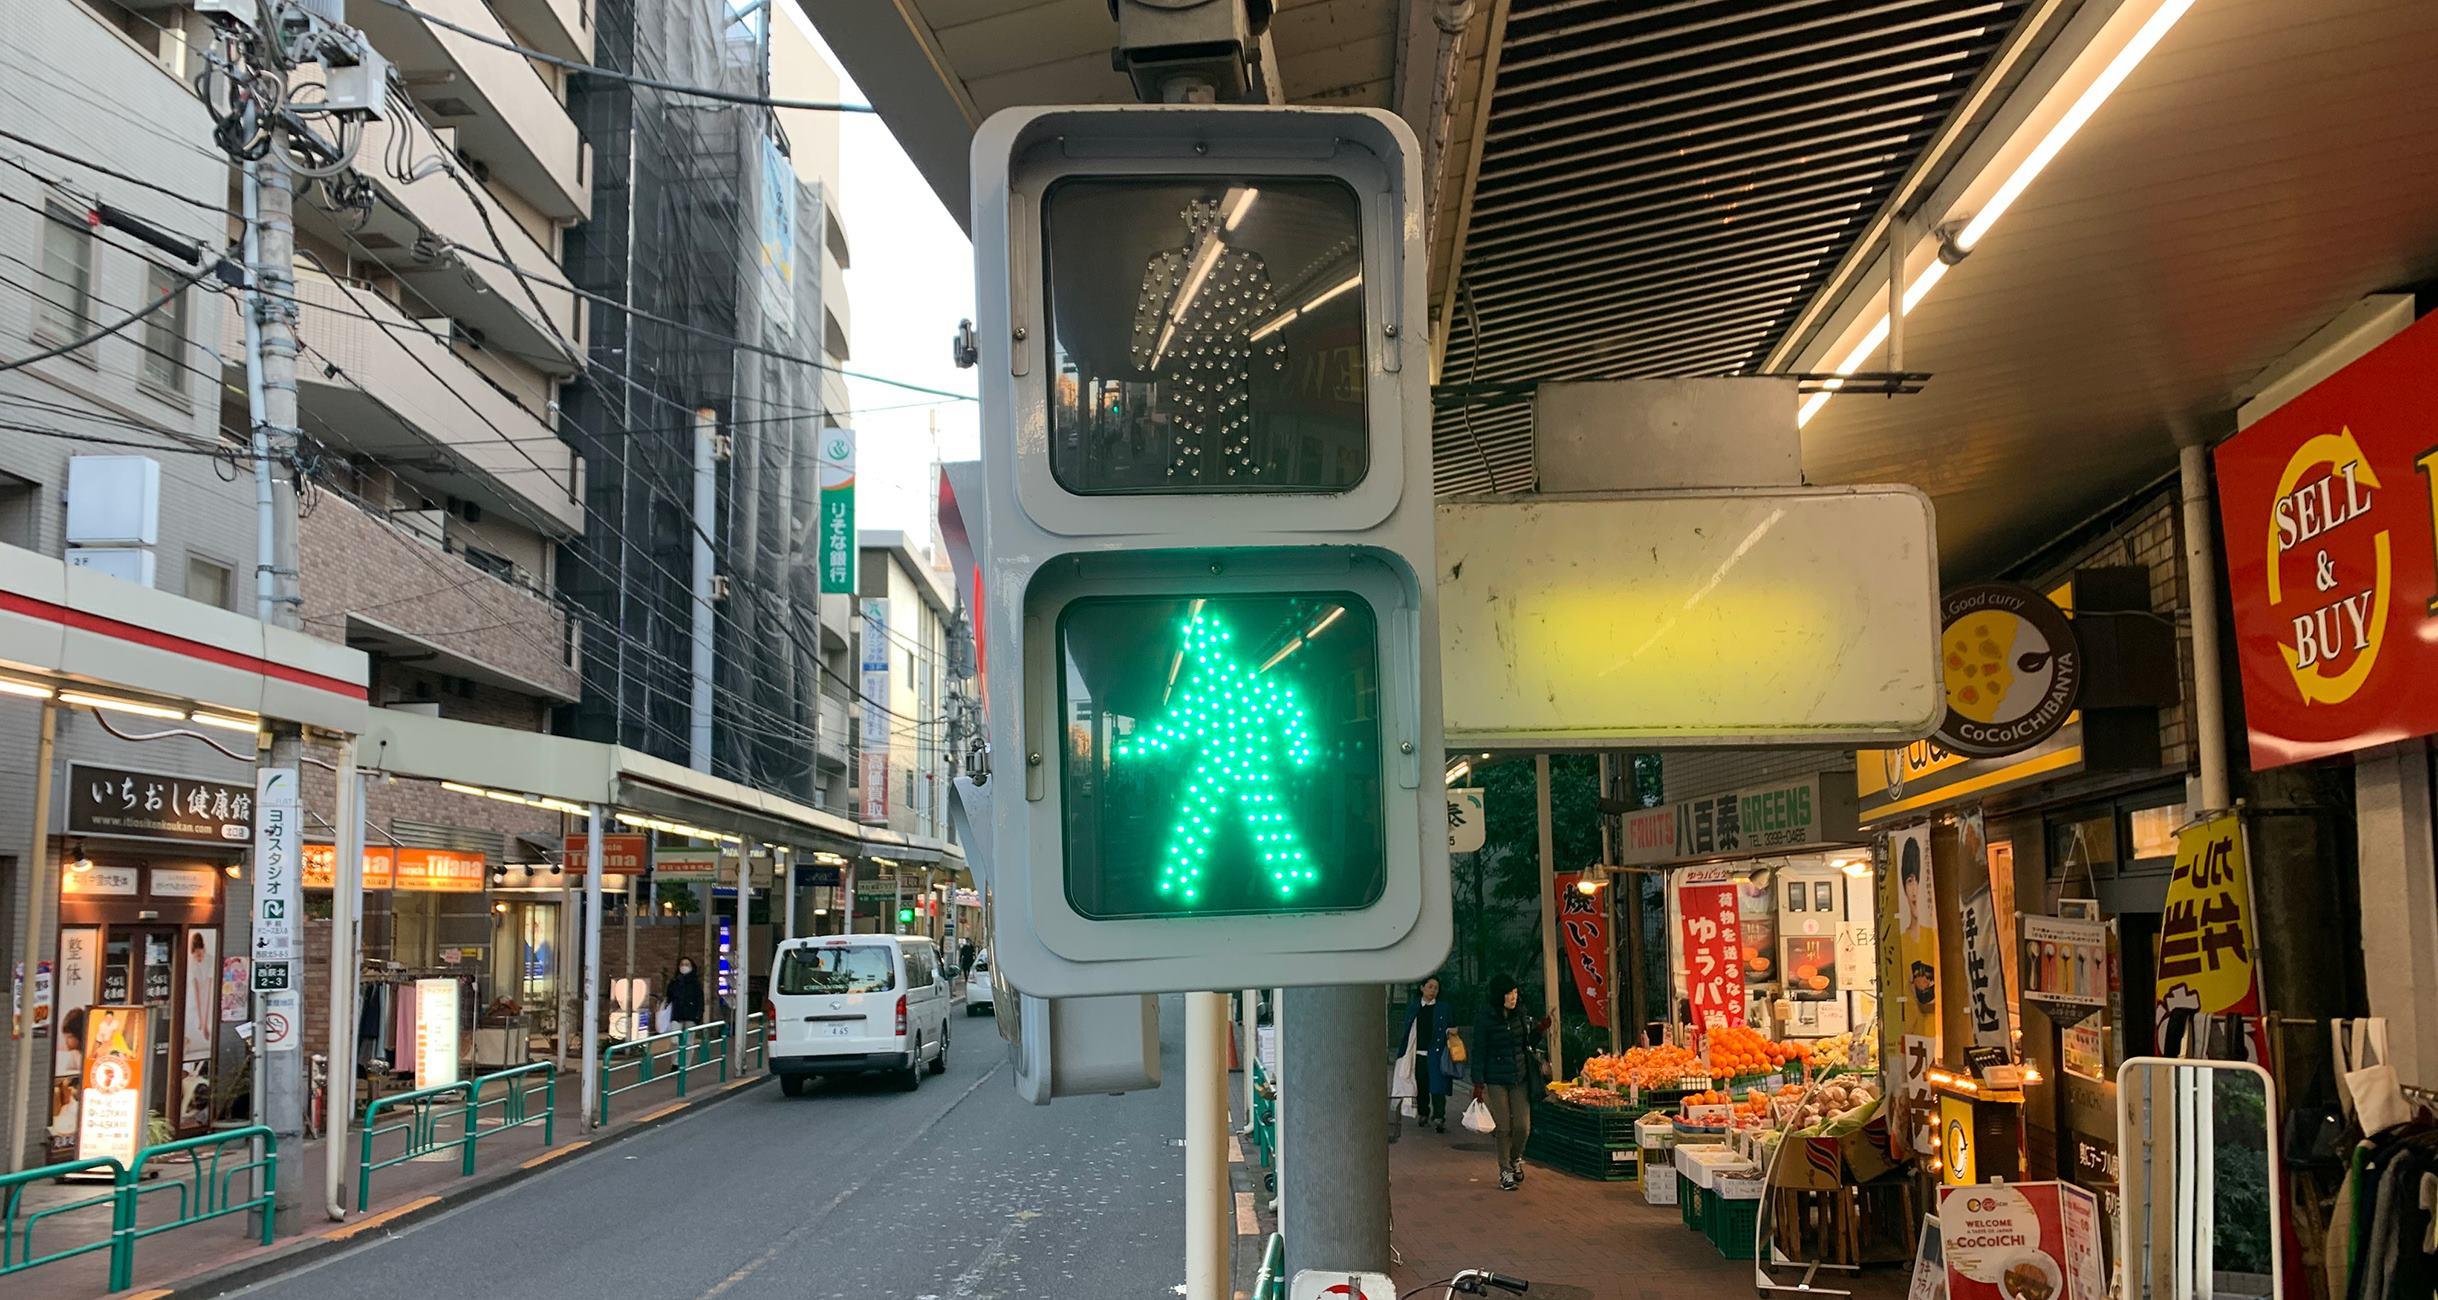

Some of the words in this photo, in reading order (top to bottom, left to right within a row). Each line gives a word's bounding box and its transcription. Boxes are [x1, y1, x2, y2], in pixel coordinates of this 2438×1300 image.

[2276, 462, 2371, 552] SELL
[829, 502, 848, 583] りそな銀行
[2316, 550, 2338, 591] &
[1949, 592, 1986, 615] Good
[1988, 593, 2025, 610] curry
[2292, 590, 2372, 669] BUY
[1960, 652, 2073, 742] CoCoICHIBANYA
[91, 776, 251, 821] いちおし健康館
[1741, 785, 1812, 834] GREENS
[1629, 811, 1674, 850] FRUITS
[1675, 794, 1740, 857] 八百泰
[266, 809, 283, 895] ヨガスタジオ
[258, 968, 286, 977] 西荻北
[1718, 891, 1743, 1014] 荷物を送るなら
[261, 978, 282, 986] 2-3
[1957, 1234, 2025, 1248] CoCoICHI
[1965, 1219, 2012, 1228] WELCOME
